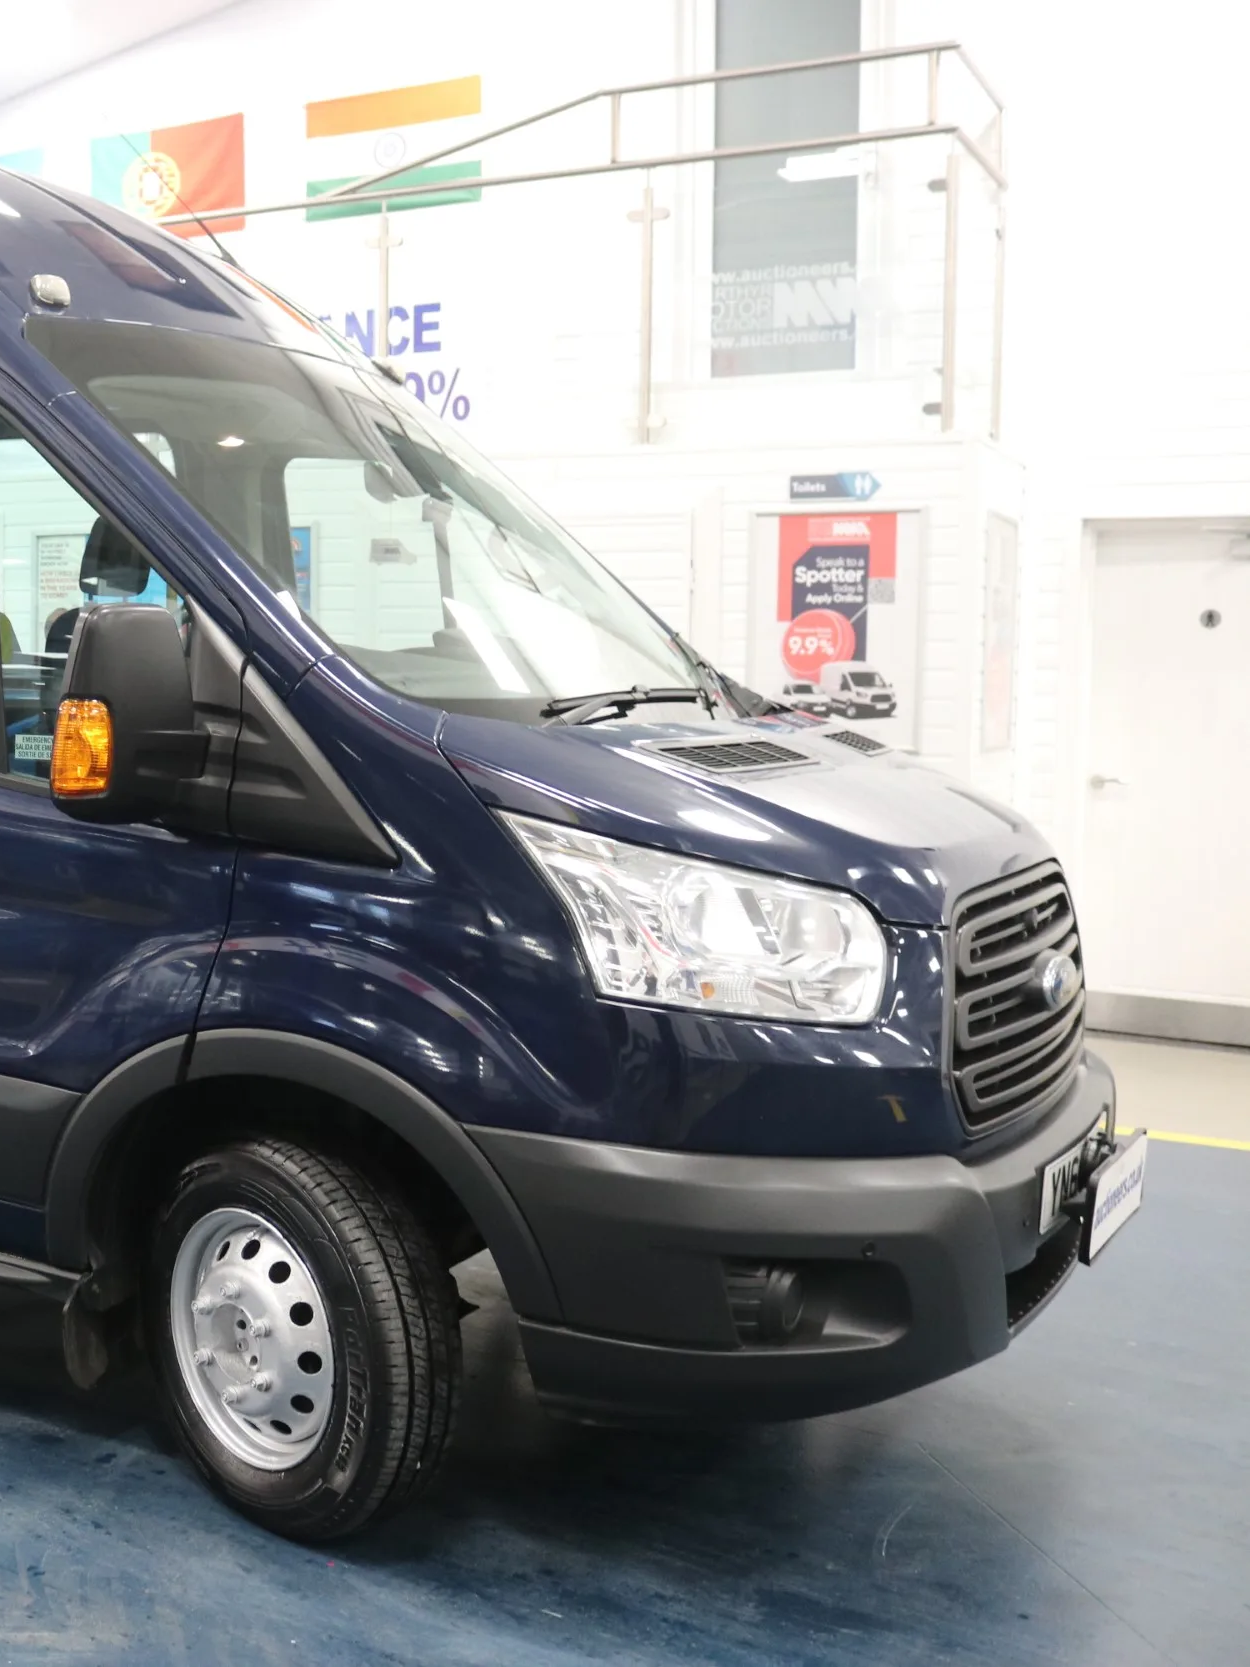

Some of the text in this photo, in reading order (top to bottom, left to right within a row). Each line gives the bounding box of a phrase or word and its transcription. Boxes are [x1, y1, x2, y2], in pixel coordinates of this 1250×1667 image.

[318, 303, 441, 357] NCE
[792, 481, 826, 493] Toilets
[816, 557, 845, 569] Speak
[846, 557, 857, 567] to
[794, 566, 865, 587] Spotter
[805, 594, 864, 605] Apply Online
[788, 636, 835, 656] 9.9%
